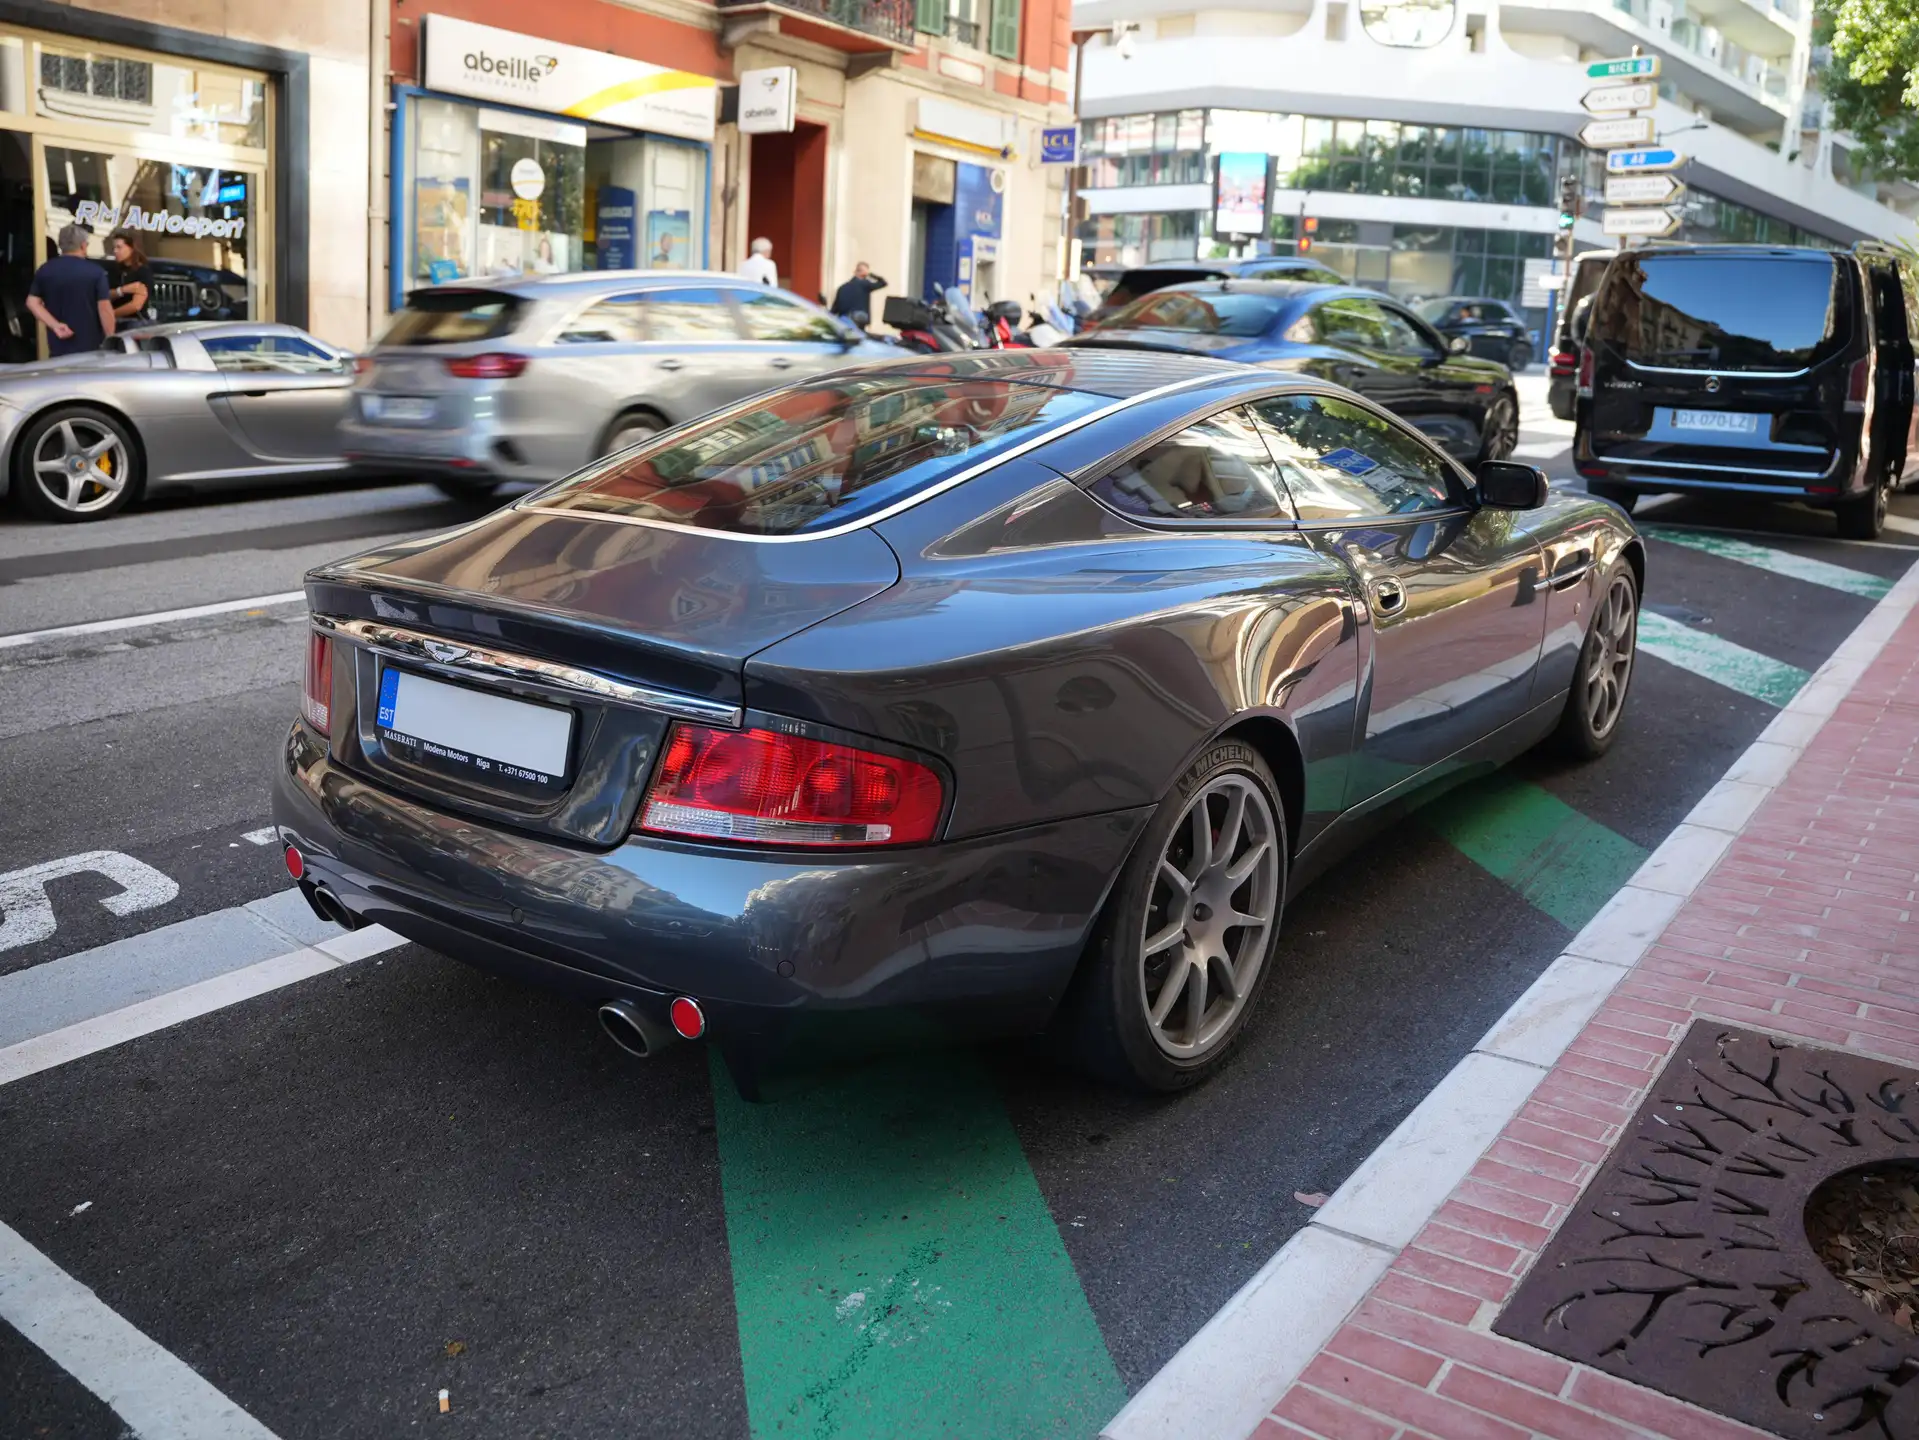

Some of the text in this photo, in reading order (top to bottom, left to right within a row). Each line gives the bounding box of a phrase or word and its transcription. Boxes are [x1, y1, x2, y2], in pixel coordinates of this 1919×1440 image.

[464, 50, 541, 83] abeille
[75, 200, 245, 239] RM Autosport
[379, 706, 395, 722] EST
[383, 729, 417, 747] MASERATI
[423, 742, 447, 758] Modena
[447, 749, 469, 763] Motors
[476, 757, 490, 770] Riga
[504, 766, 517, 776] +371
[518, 769, 536, 781] 67500
[537, 774, 548, 784] 100
[1194, 745, 1253, 776] MICHELIN
